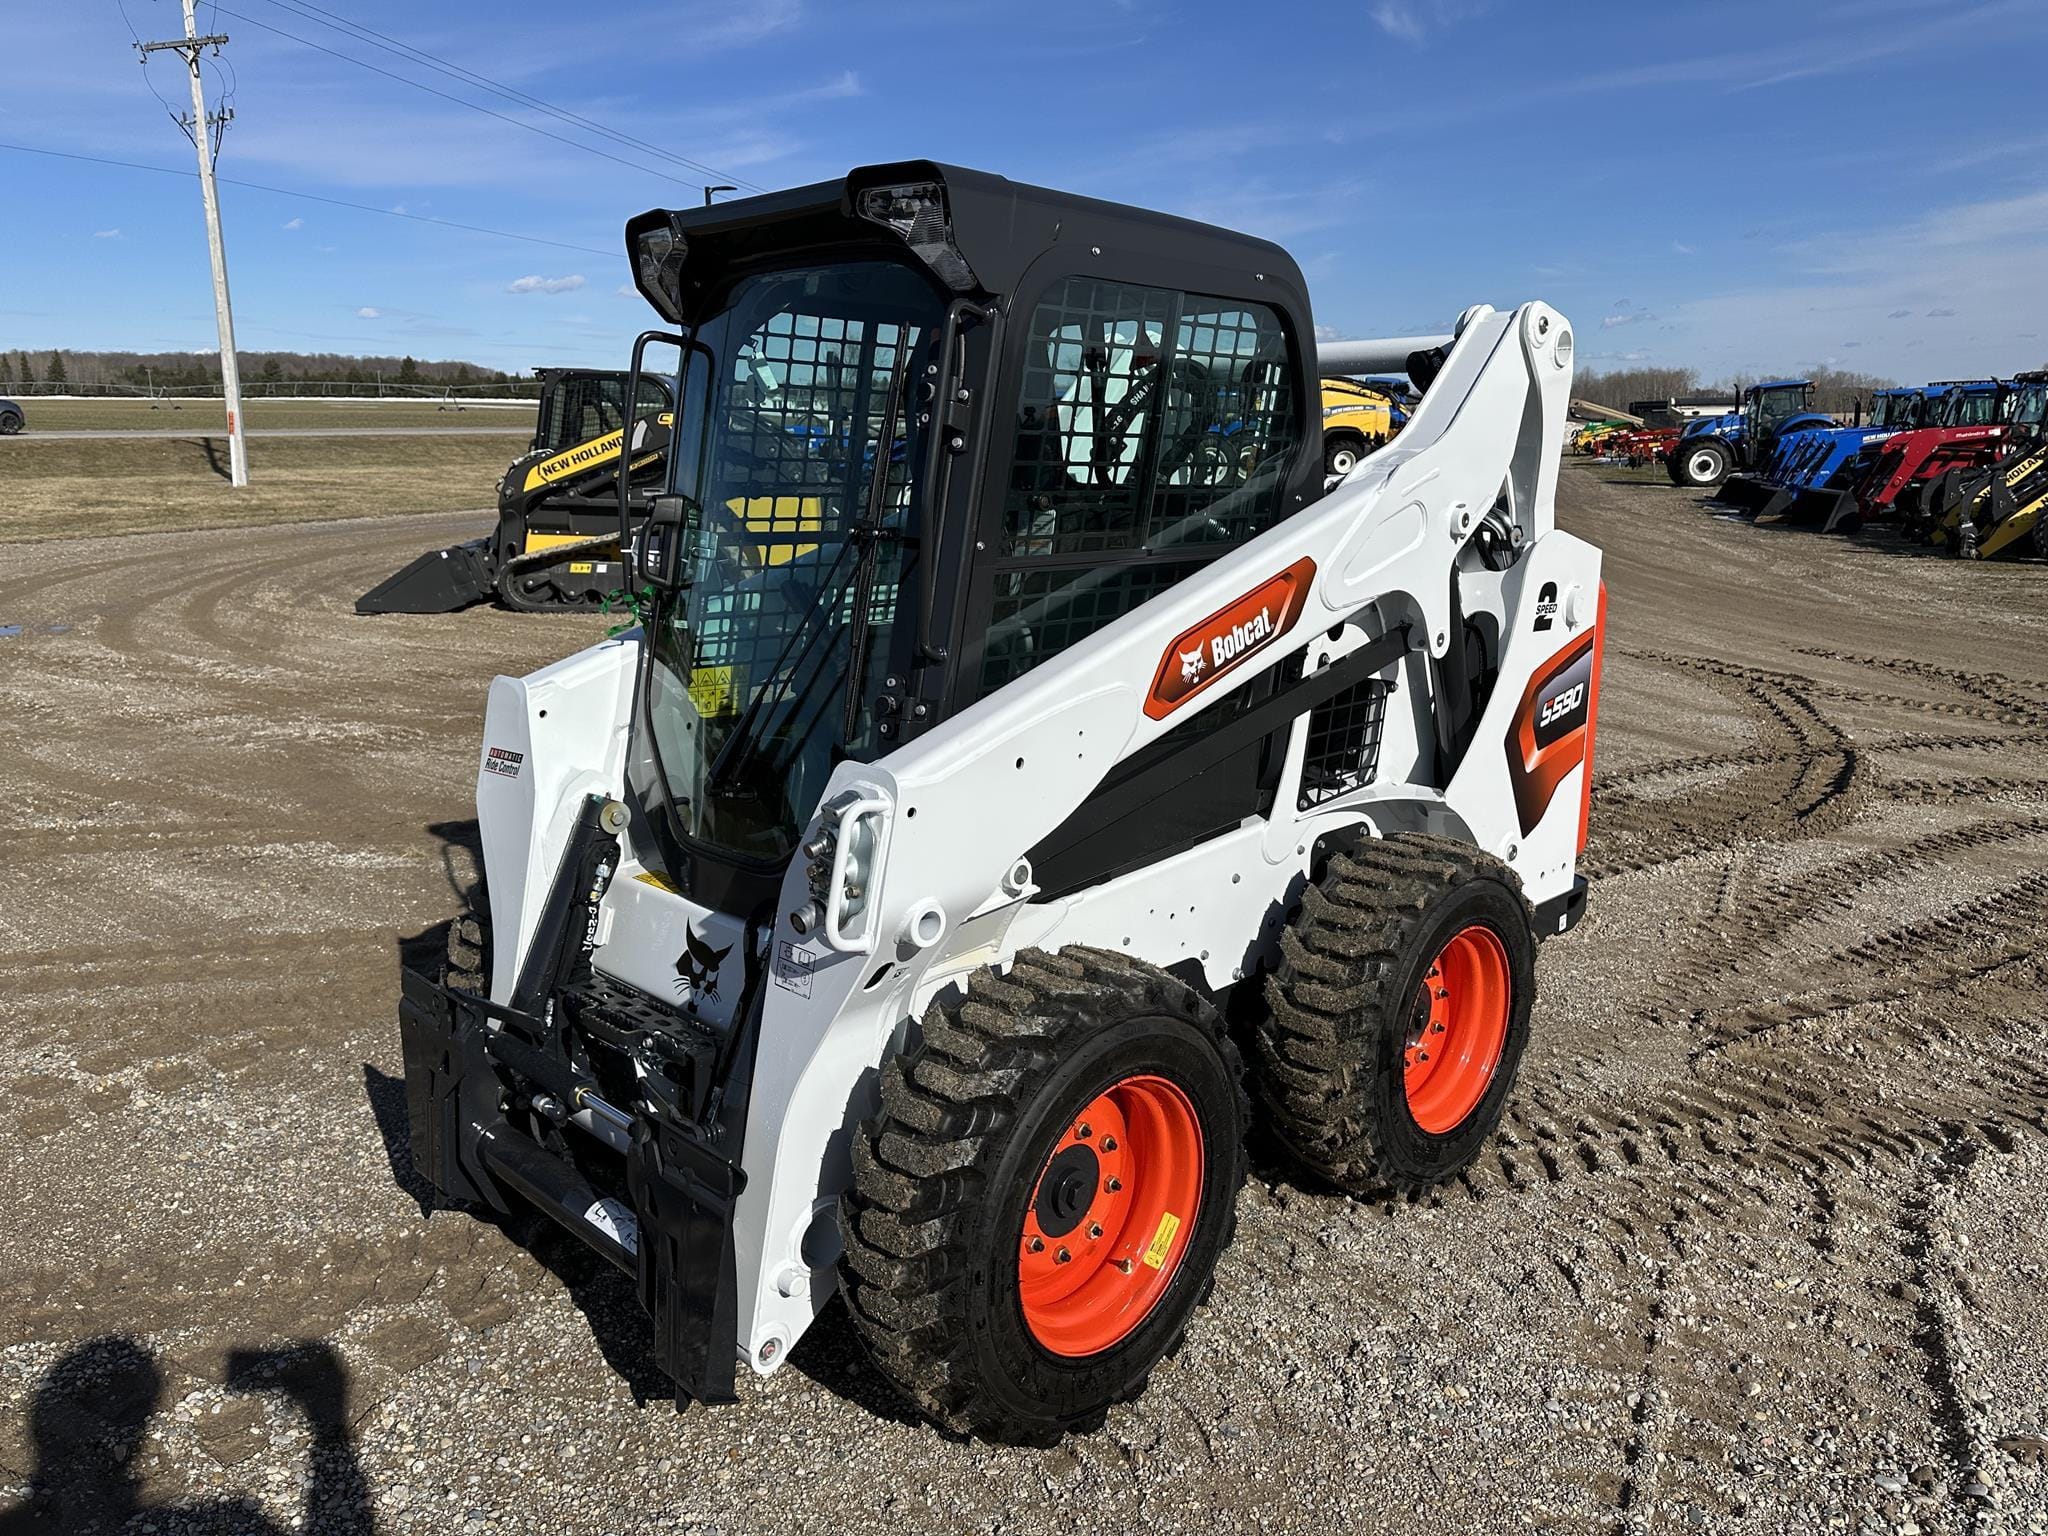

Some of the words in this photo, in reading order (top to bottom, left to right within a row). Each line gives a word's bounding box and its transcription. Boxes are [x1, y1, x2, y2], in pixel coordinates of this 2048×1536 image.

[542, 458, 570, 477] NEW
[1536, 604, 1557, 615] SPEED
[1211, 606, 1271, 668] Bobcat
[1540, 682, 1584, 728] S590
[490, 749, 522, 762] AUTOMATIC
[485, 757, 498, 770] Ride
[499, 761, 520, 775] Control
